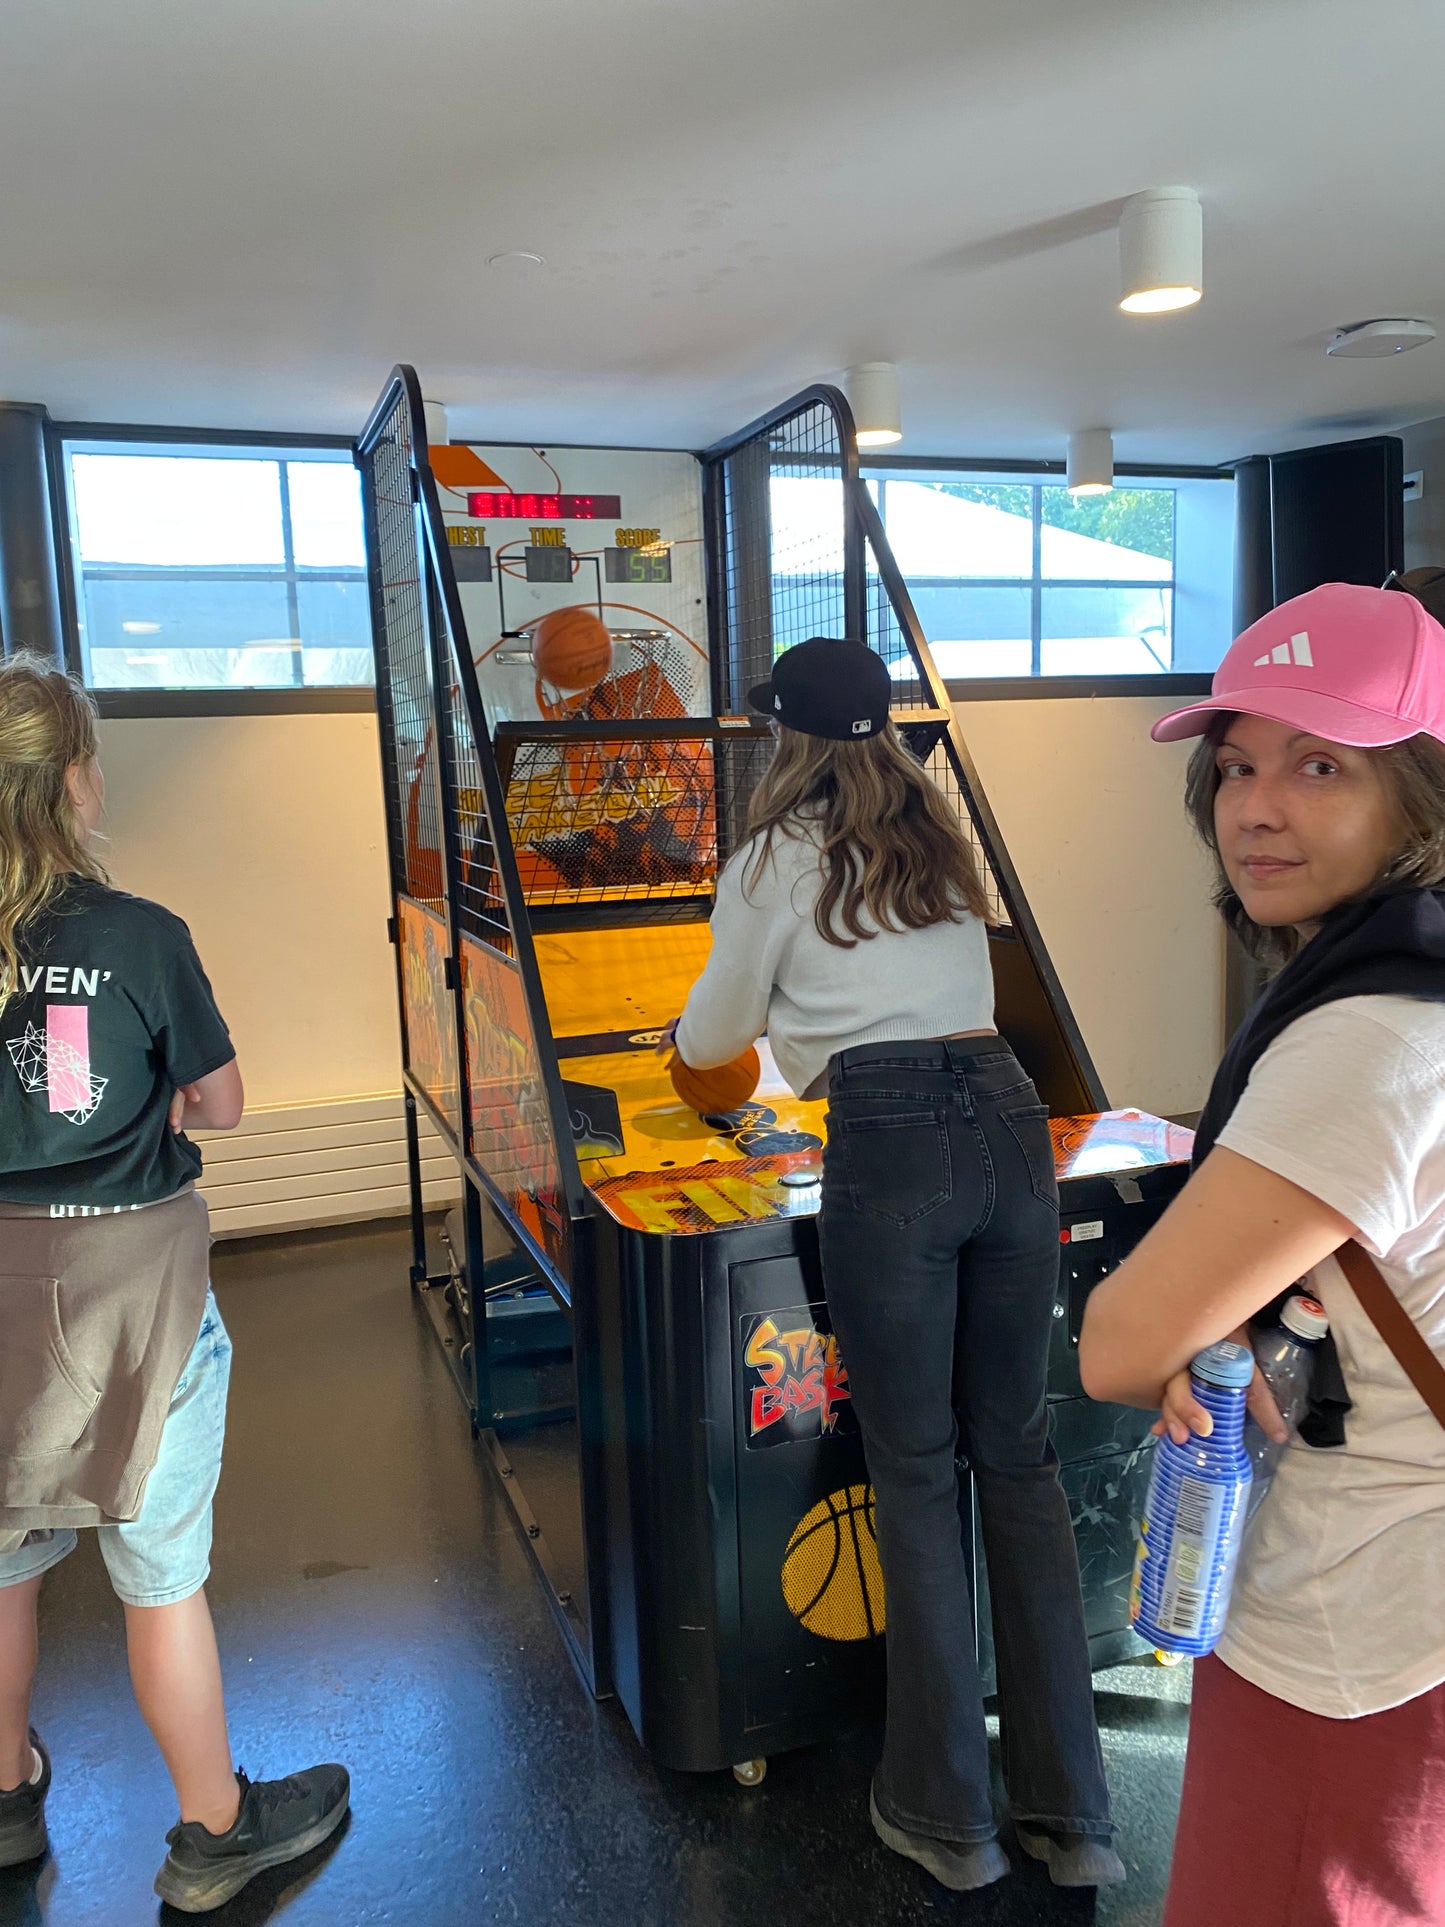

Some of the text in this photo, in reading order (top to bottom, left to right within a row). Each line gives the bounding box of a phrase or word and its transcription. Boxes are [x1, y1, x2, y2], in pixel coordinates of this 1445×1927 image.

[446, 526, 486, 545] HEST
[529, 527, 566, 546] TIME
[615, 528, 661, 547] SCORE
[630, 553, 667, 582] 55
[12, 966, 111, 996] VEN'
